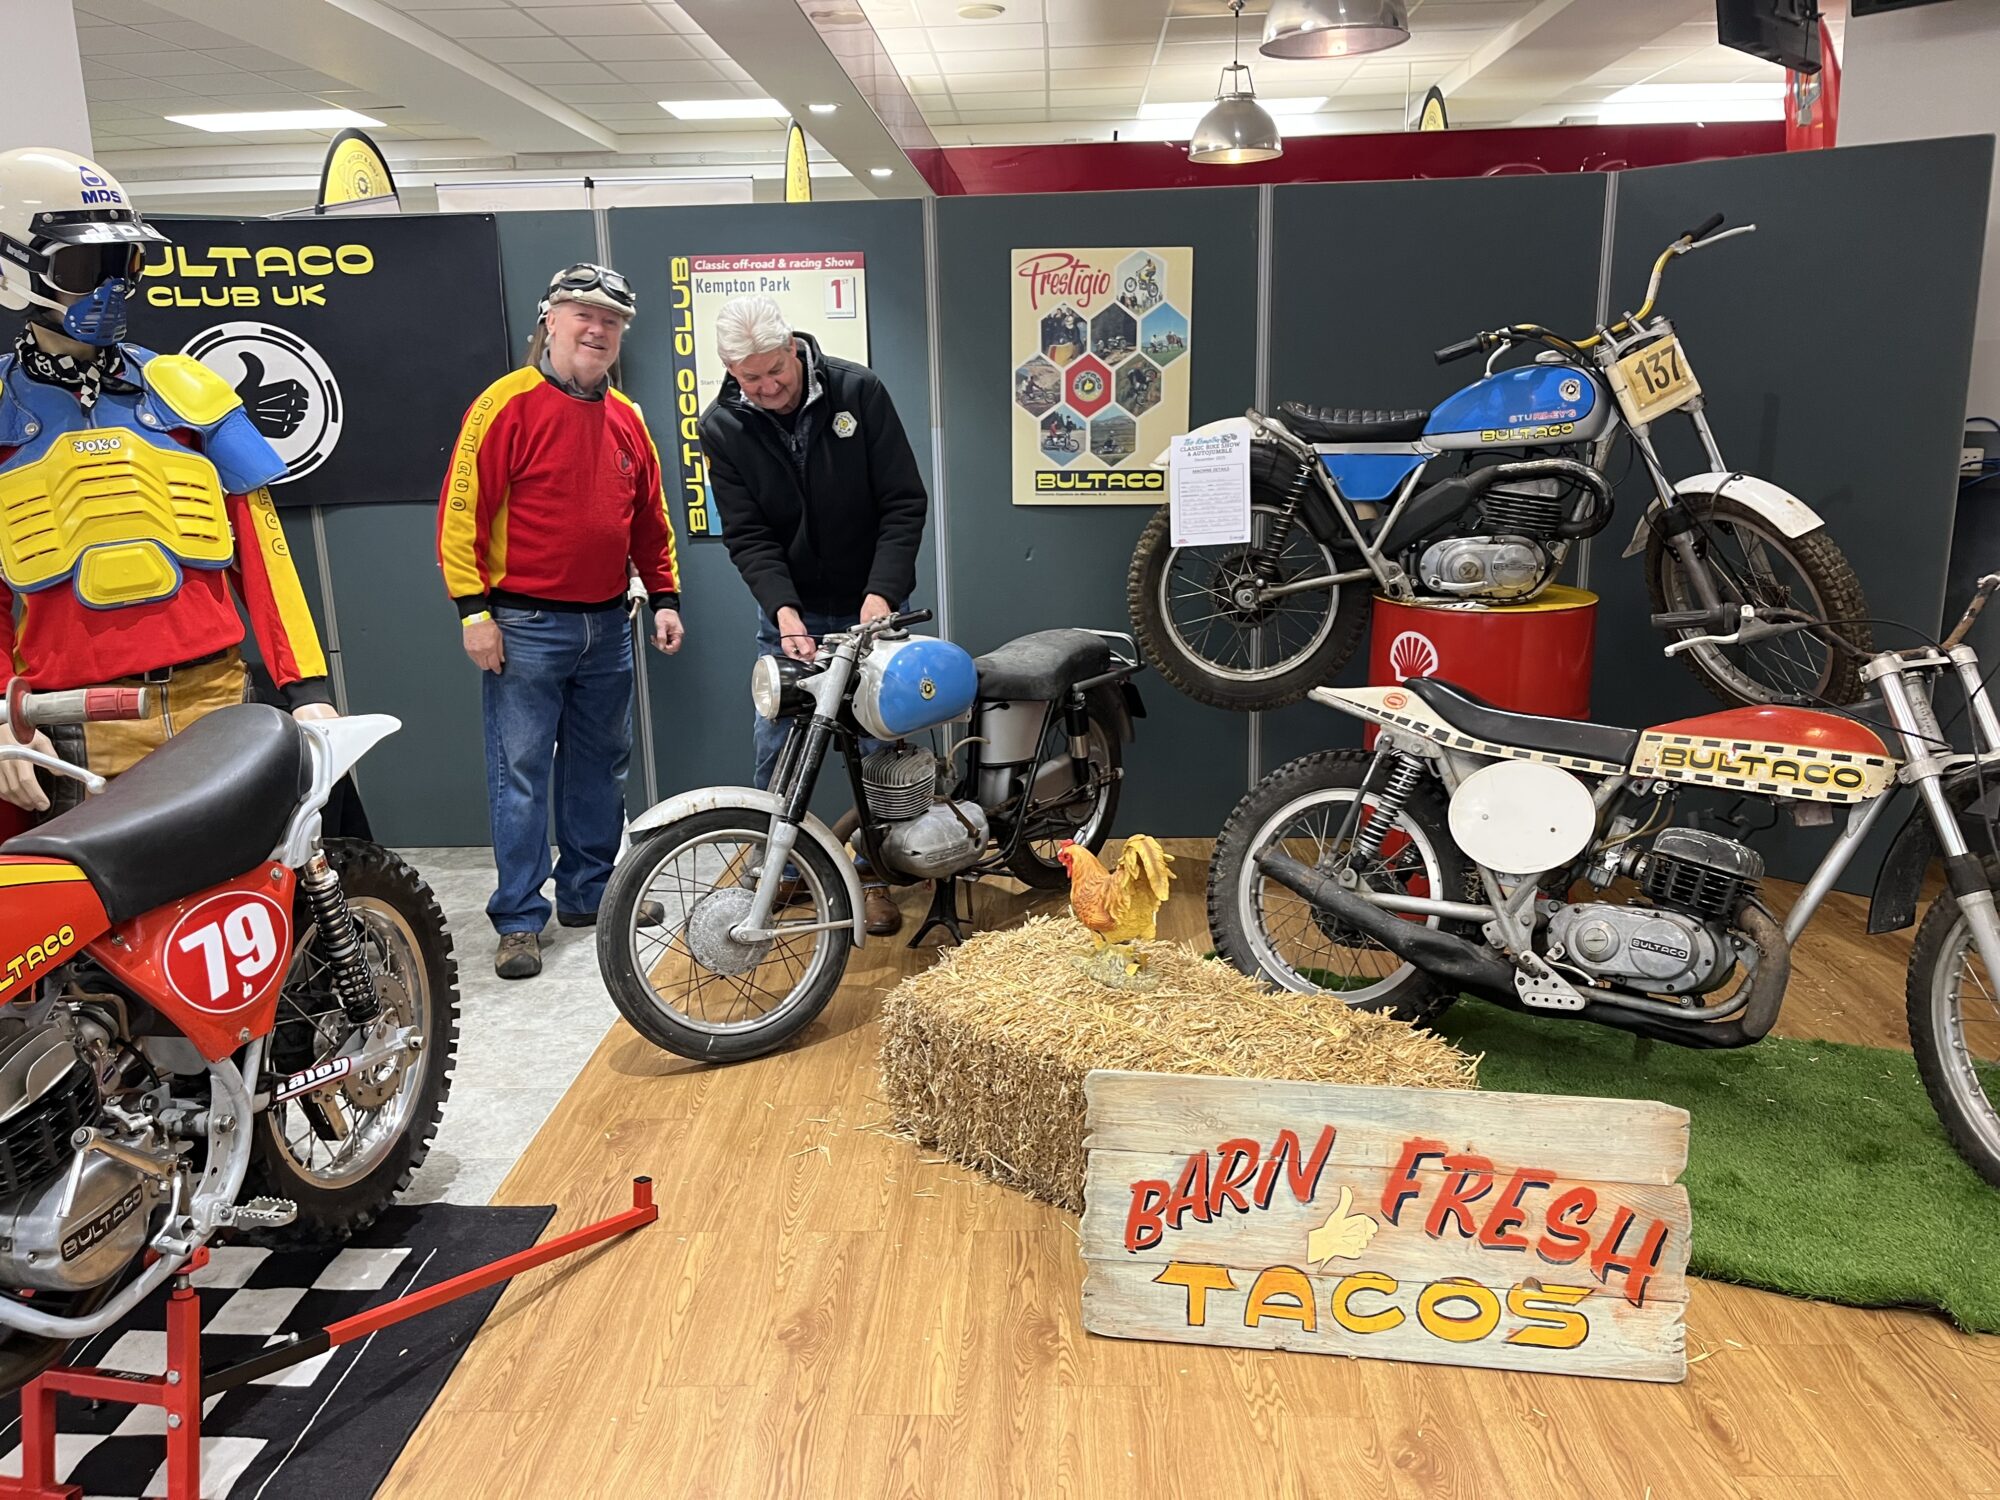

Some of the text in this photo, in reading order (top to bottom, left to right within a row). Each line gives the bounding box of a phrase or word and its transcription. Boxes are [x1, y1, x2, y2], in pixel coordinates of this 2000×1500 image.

[81, 189, 122, 204] MDS
[143, 244, 374, 278] ULTACO
[694, 256, 855, 270] Classic off-road & racing Show
[147, 283, 326, 307] CLUB UK
[695, 276, 791, 296] Kempton Park
[1015, 252, 1111, 310] Prestigio
[1635, 349, 1682, 395] 137
[671, 256, 707, 534] BULTACO CLUB
[73, 438, 121, 453] YOKO
[1180, 445, 1205, 453] CLASSIC
[1221, 441, 1240, 449] SHOW
[1481, 421, 1575, 442] BULTACO
[451, 396, 494, 512] BULTACO
[1192, 448, 1232, 457] AUTOJUMBLE
[1036, 472, 1163, 489] BULTACO
[1660, 747, 1863, 788] BULTACO
[0, 924, 75, 992] TACO
[178, 902, 277, 1002] 79
[1632, 939, 1687, 958] BULTACO
[63, 1189, 142, 1257] BULTACO
[1124, 1124, 1671, 1309] BARN FRESH
[1153, 1260, 1595, 1350] TACOS
